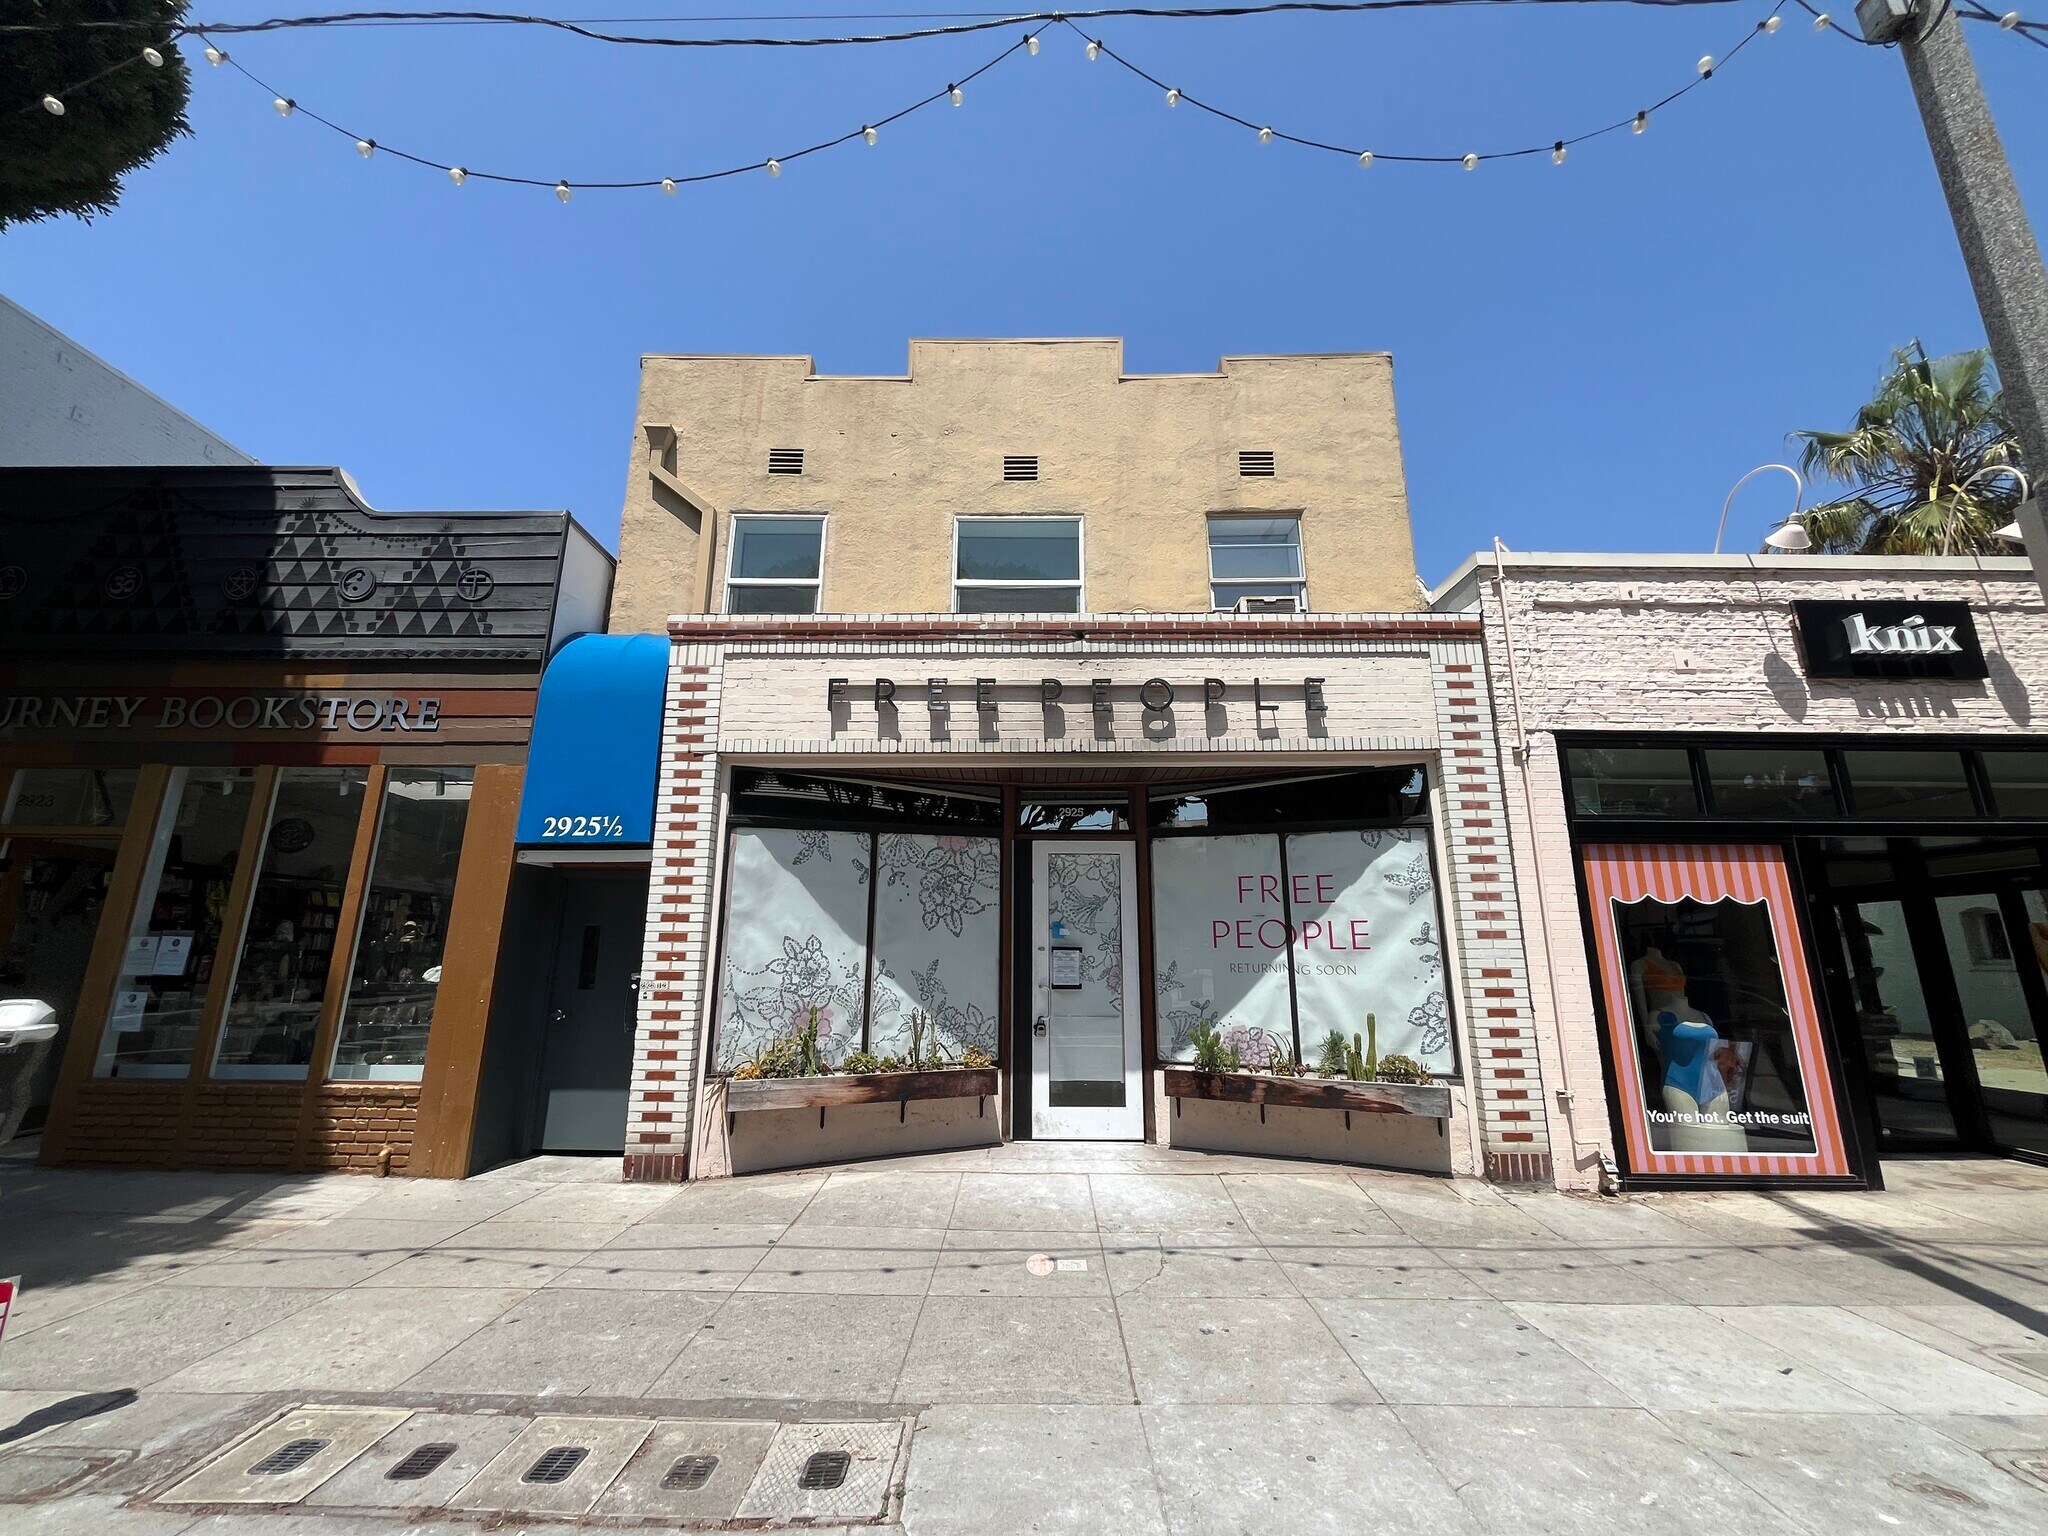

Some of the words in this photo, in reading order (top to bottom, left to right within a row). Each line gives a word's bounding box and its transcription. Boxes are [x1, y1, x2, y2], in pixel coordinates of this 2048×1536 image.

[1842, 612, 1963, 654] knix
[827, 677, 997, 713] FREE
[1041, 677, 1329, 713] PEOPLE
[154, 696, 440, 732] BOOKSTORE
[1059, 807, 1084, 817] 2925
[1237, 874, 1336, 904] FREE
[1212, 919, 1372, 950] PEOPLE
[1229, 962, 1311, 976] RETURNING
[1316, 964, 1357, 976] SOON
[1695, 1110, 1724, 1123] hot.
[1726, 1111, 1752, 1124] Get
[1756, 1111, 1779, 1124] the
[1781, 1111, 1810, 1125] suit
